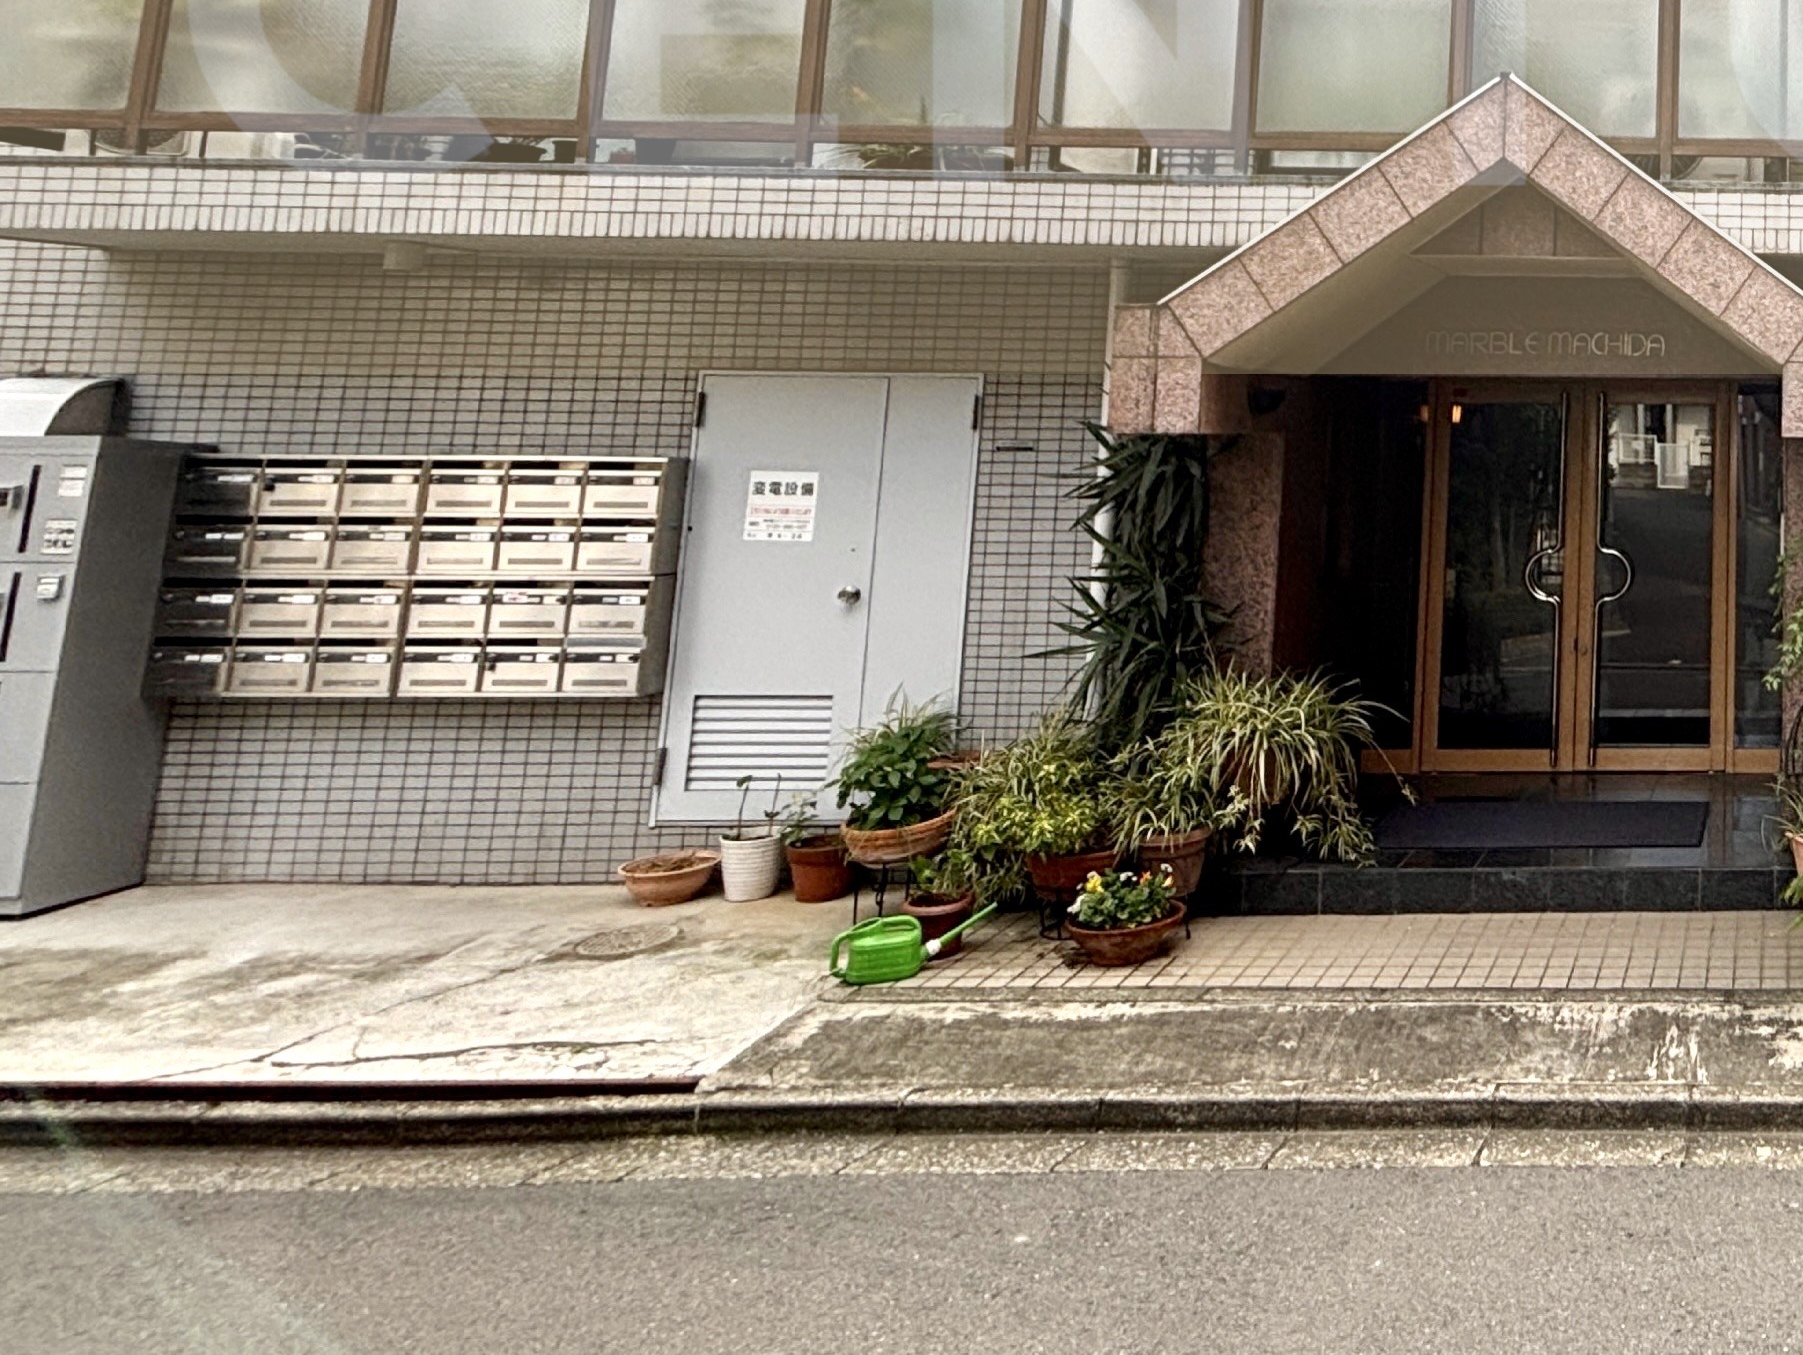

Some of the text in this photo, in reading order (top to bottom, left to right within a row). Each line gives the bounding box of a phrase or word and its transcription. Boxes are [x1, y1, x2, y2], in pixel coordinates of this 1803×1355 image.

[1425, 330, 1667, 358] MARBLE MACHIDA
[752, 481, 814, 496] 変電設備
